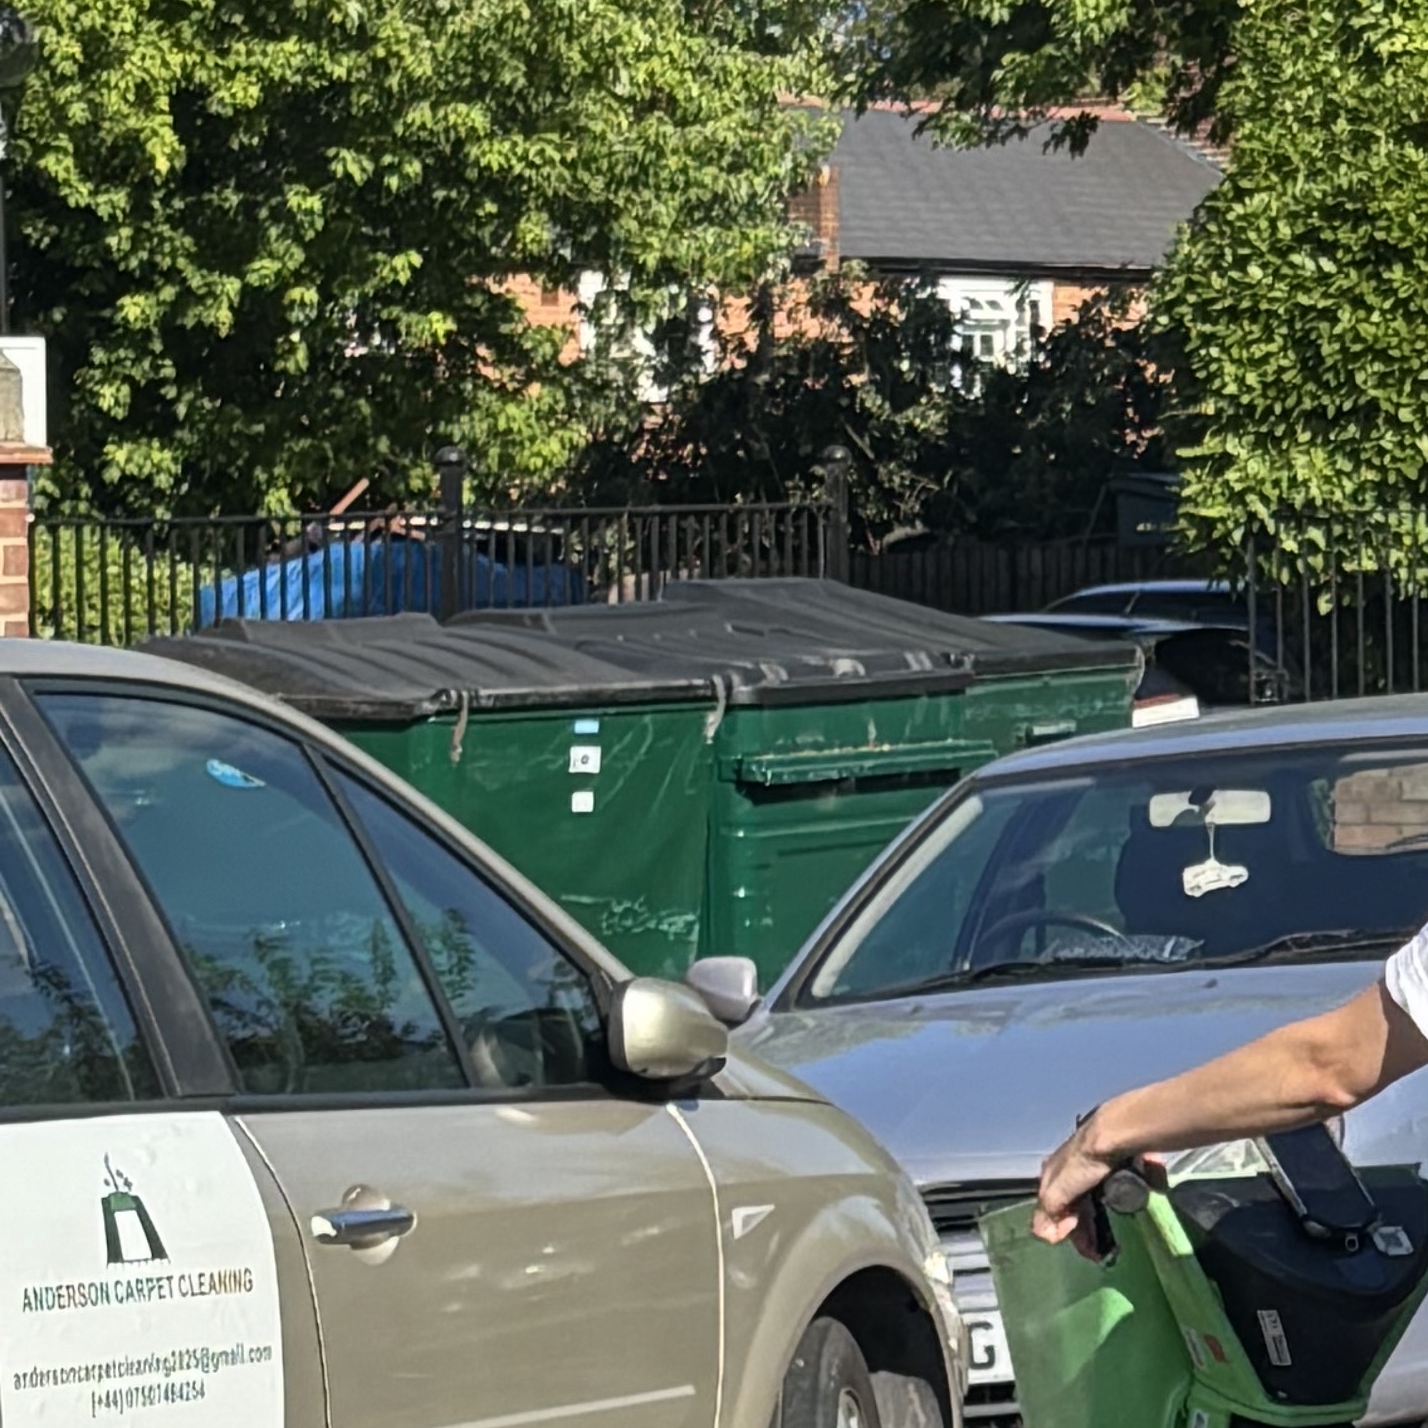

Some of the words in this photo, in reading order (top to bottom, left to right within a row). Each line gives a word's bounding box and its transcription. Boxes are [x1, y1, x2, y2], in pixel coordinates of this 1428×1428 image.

[22, 1281, 111, 1313] ANDERSON
[113, 1275, 174, 1305] CARPET
[178, 1267, 253, 1298] CLEANING
